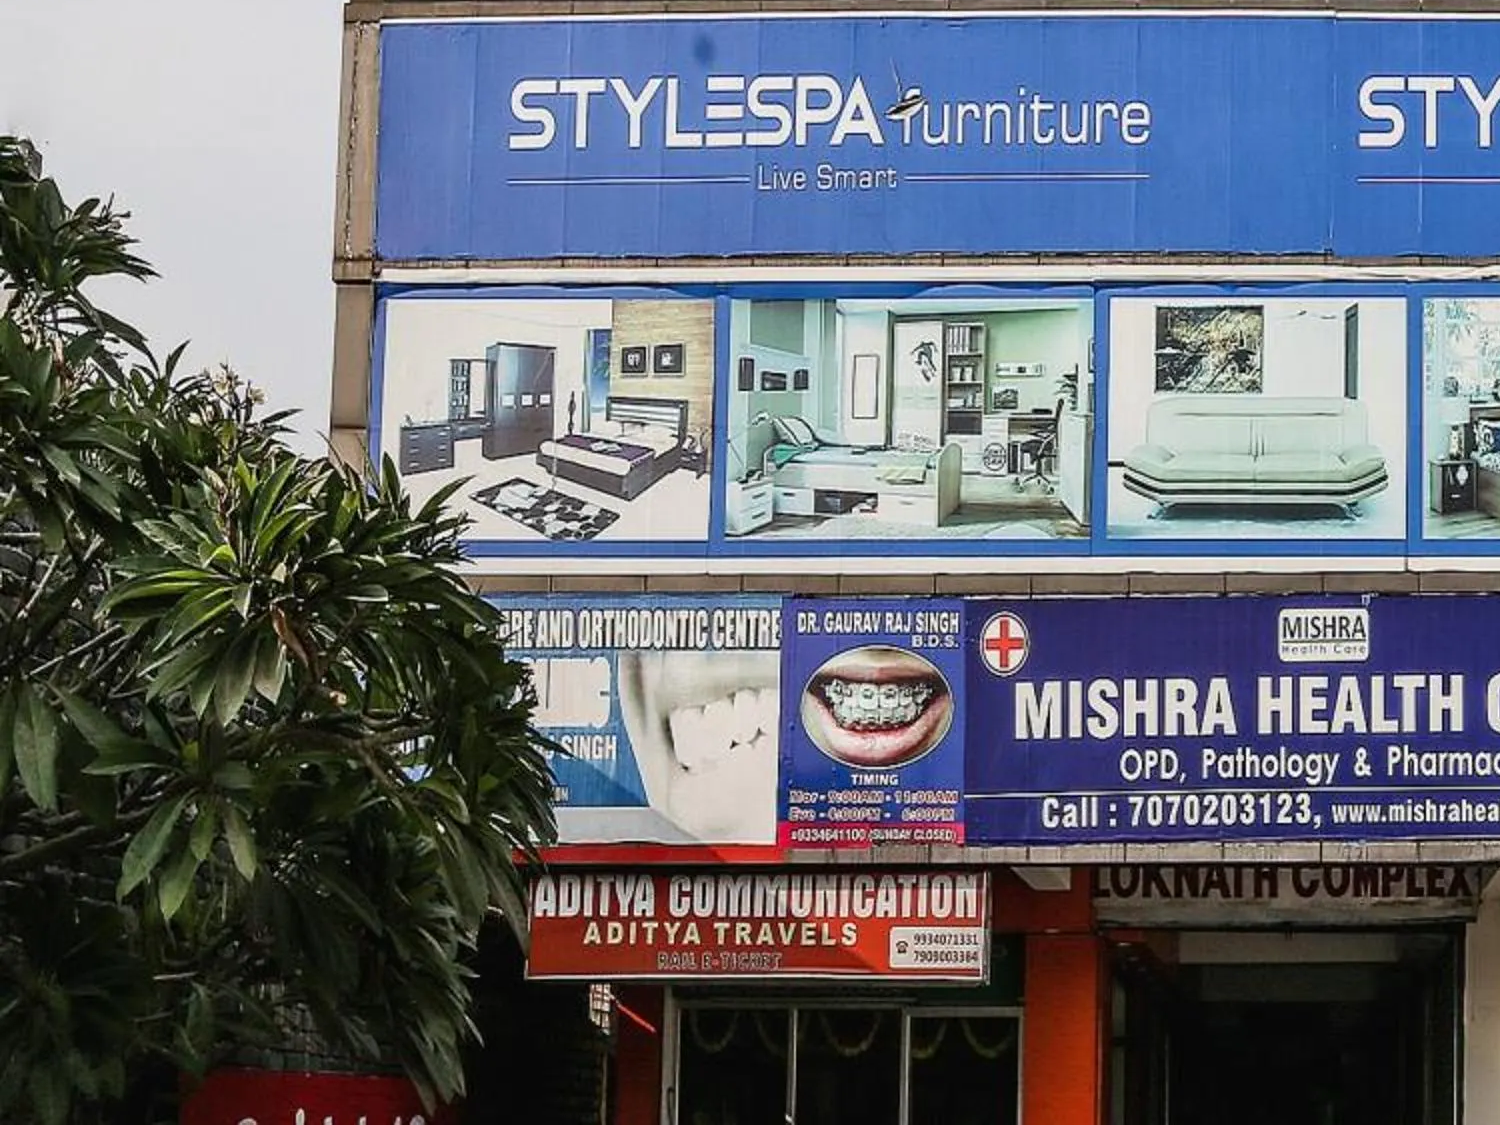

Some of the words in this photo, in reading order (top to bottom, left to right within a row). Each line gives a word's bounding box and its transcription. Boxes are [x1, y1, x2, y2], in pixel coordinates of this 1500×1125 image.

[508, 75, 884, 150] STYLESPA
[901, 86, 1152, 146] furniture
[757, 164, 807, 190] Live
[816, 164, 898, 190] Smart
[535, 610, 575, 648] AND
[578, 608, 709, 650] ORTHODONTIC
[713, 608, 781, 650] CENTRE
[797, 612, 821, 634] DR.
[824, 612, 881, 634] GAURAV
[884, 612, 911, 634] RAJ
[915, 612, 960, 634] SINGH
[1282, 615, 1367, 639] MISHRA
[911, 635, 959, 649] B.D.S.
[1014, 676, 1239, 740] MISHRA
[1257, 674, 1465, 737] HEALTH
[560, 734, 617, 760] SINGH
[851, 774, 899, 786] TIMING
[1119, 749, 1187, 784] OPD,
[1201, 747, 1340, 786] Pathology
[1354, 749, 1373, 777] &
[1041, 797, 1098, 829] Call
[1128, 794, 1322, 830] 7070203123,
[1093, 865, 1279, 897] LOKNATH
[1291, 865, 1473, 898] COMPLEX
[534, 875, 656, 919] ADITYA
[668, 875, 977, 920] COMMUNICATION
[583, 922, 702, 946] ADITYA
[713, 922, 859, 946] TRAVELS
